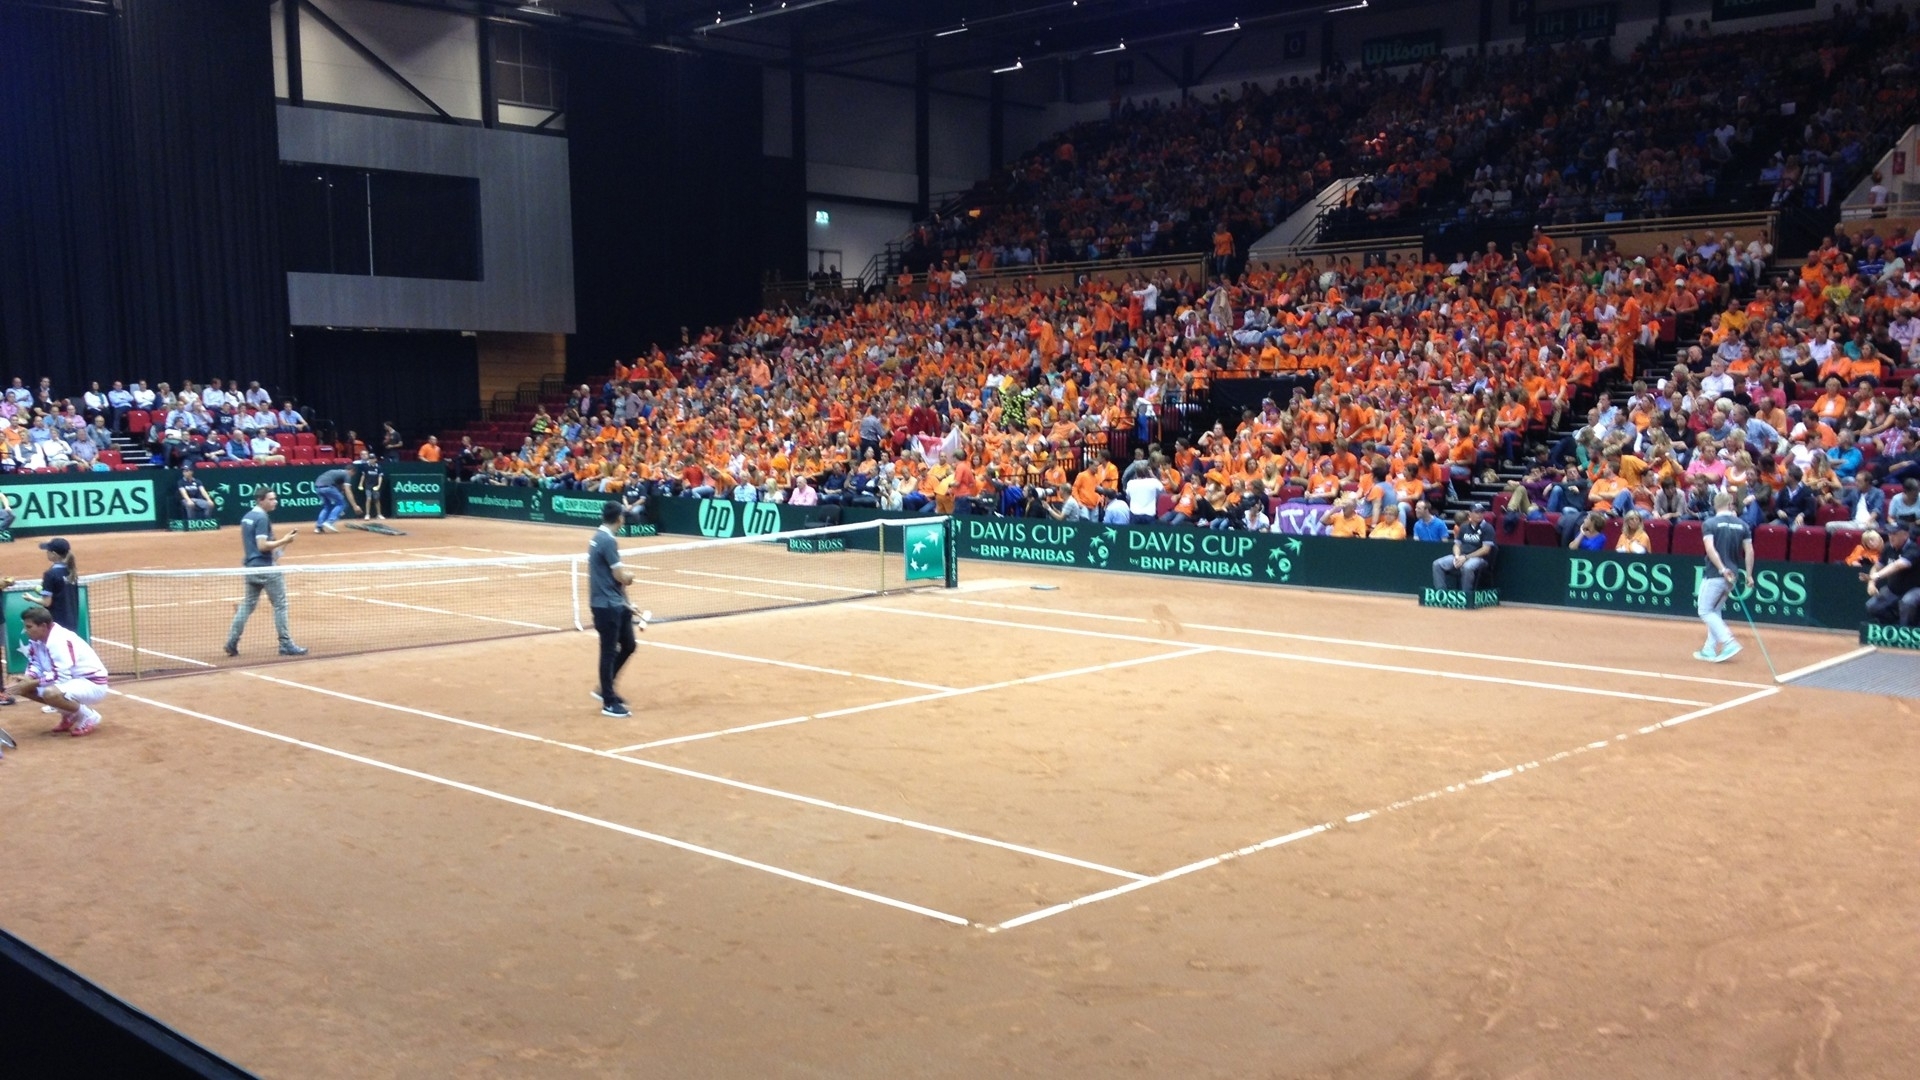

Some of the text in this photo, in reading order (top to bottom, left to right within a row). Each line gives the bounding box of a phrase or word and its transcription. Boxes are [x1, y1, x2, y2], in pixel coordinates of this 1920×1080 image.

[1365, 39, 1437, 66] Wilson
[393, 481, 441, 493] Adecco
[4, 486, 149, 520] PARIBAS
[280, 498, 324, 507] PARIB
[565, 499, 605, 513] BNP PARIBA
[188, 519, 217, 529] BOSS
[704, 499, 731, 537] hp
[630, 524, 656, 534] BOSS
[970, 521, 1026, 543] DAVIS
[1031, 524, 1075, 545] CUP
[790, 538, 812, 550] BOSS
[818, 538, 844, 549] BOSS
[1129, 530, 1253, 557] DAVIS CUP
[980, 545, 1010, 558] BNP
[1012, 547, 1076, 564] PARIBAS
[1129, 556, 1253, 578] by BNP PARIBAS
[1569, 557, 1674, 595] BOSS
[1425, 587, 1467, 606] BOSS
[1474, 588, 1498, 605] BOSS
[1569, 589, 1672, 607] HUGO BOSS
[1755, 603, 1805, 617] BOSS
[1867, 623, 1920, 643] BOSS
